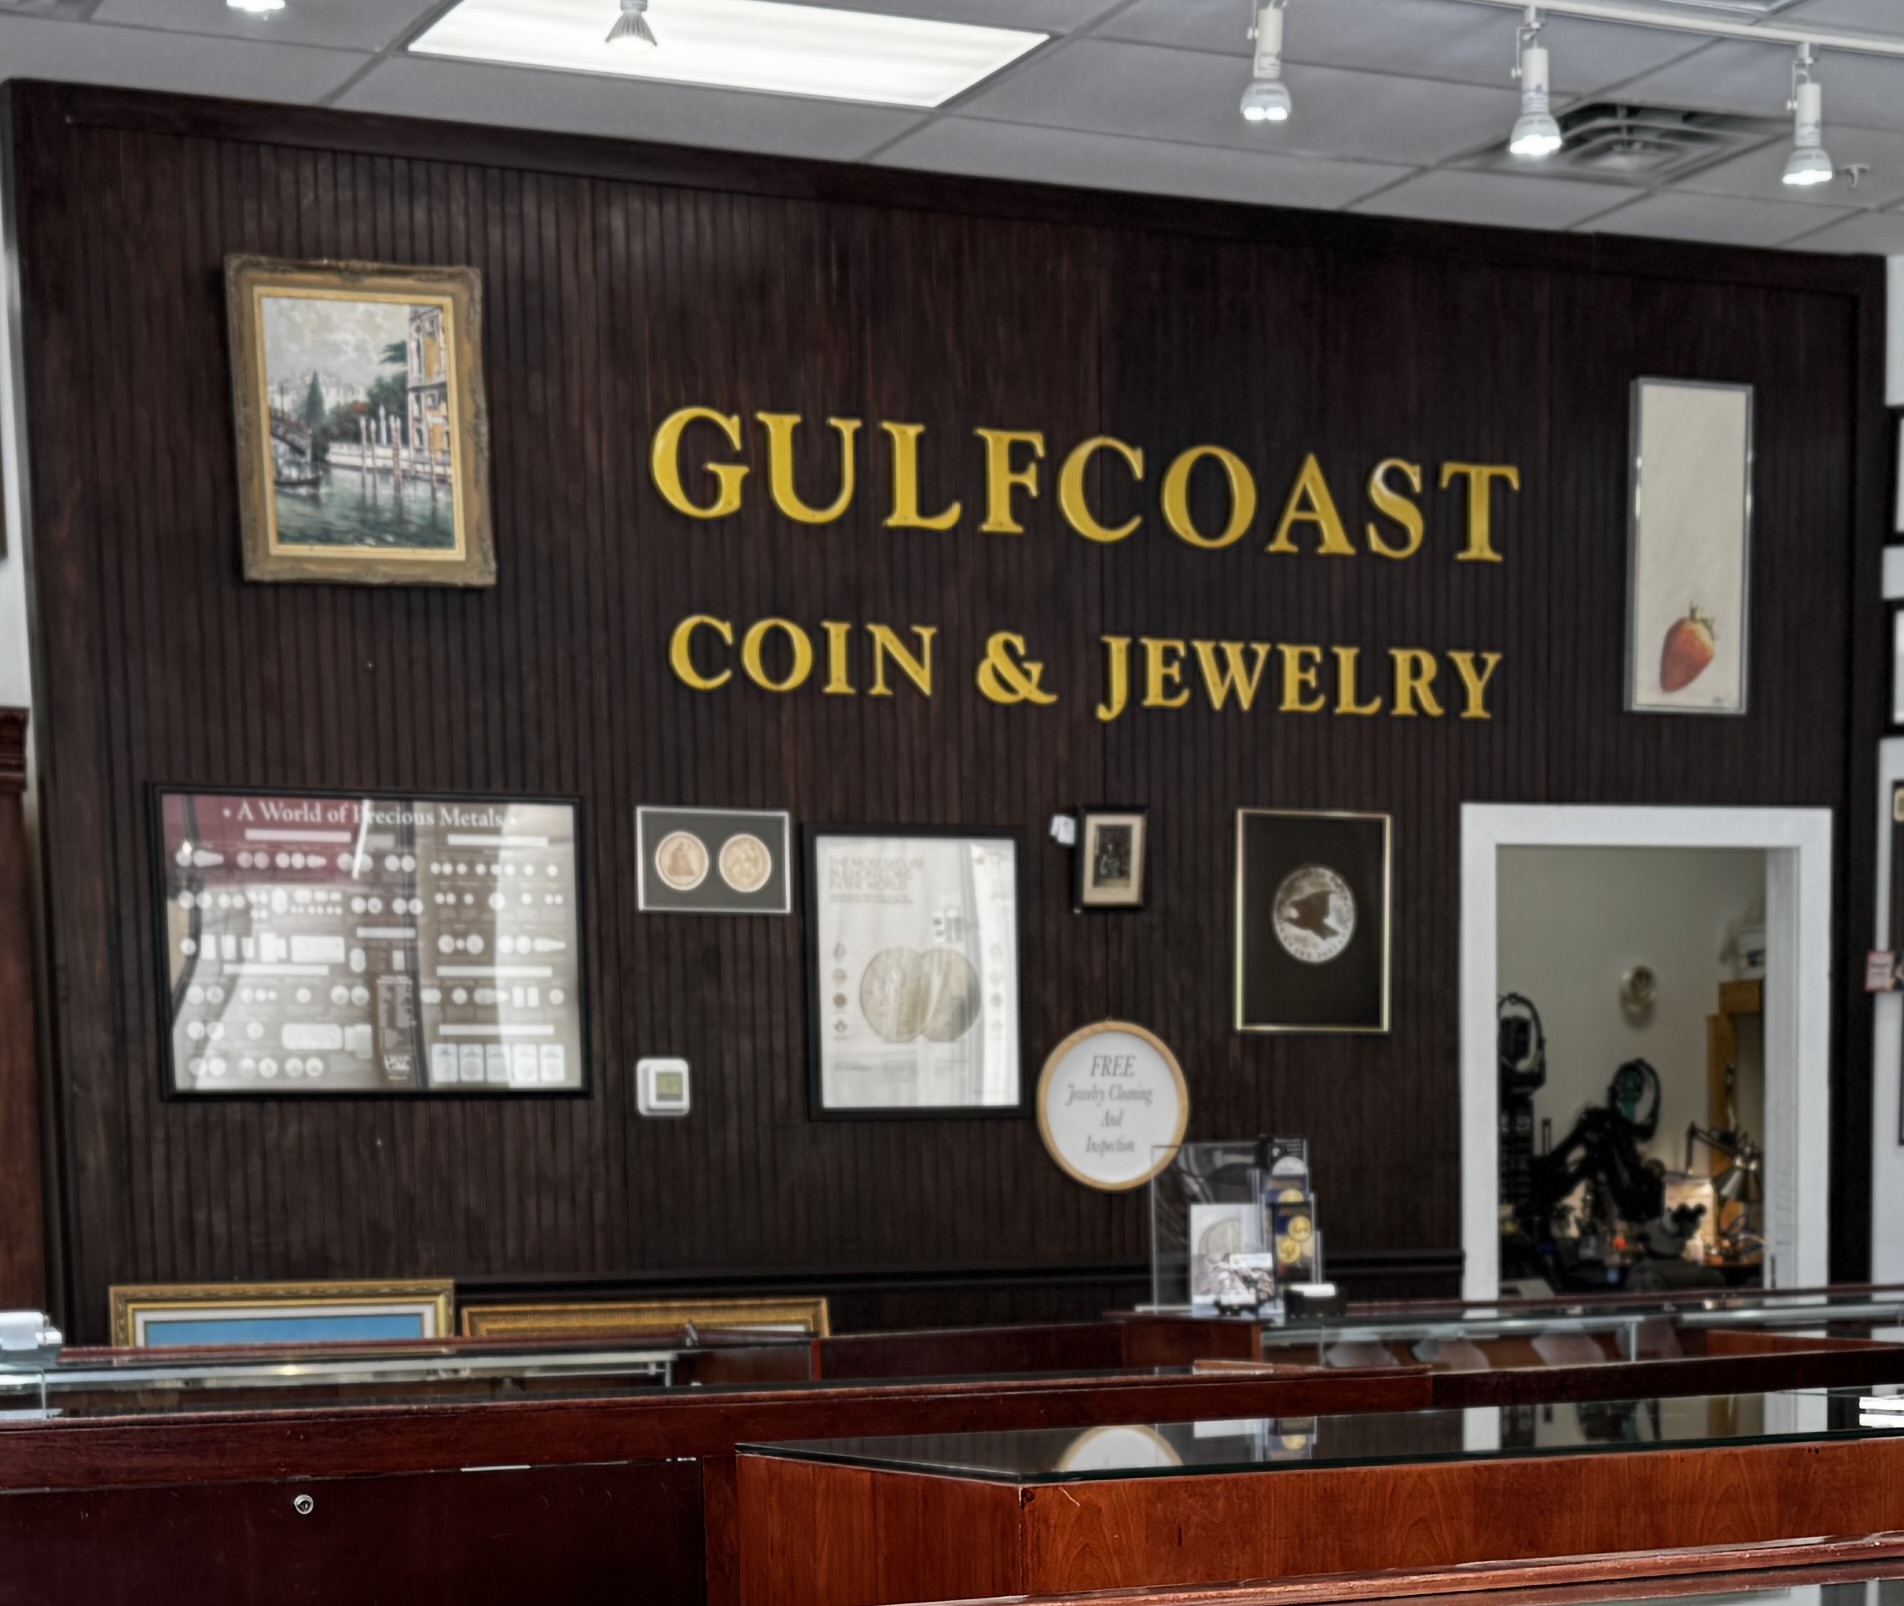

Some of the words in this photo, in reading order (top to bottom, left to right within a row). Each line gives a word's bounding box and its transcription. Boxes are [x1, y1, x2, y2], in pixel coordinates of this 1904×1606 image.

[651, 406, 1521, 562] GULFCOAST
[668, 614, 937, 697] COIN
[977, 632, 1058, 705] &
[1096, 635, 1502, 721] JEWELRY
[237, 801, 254, 820] A
[260, 802, 323, 822] World
[327, 803, 349, 823] of
[440, 808, 503, 827] Metals
[1090, 1055, 1136, 1078] FREE
[1065, 1083, 1105, 1106] Jewelry
[1108, 1083, 1153, 1106] Cleaning
[1100, 1109, 1124, 1128] And
[1086, 1134, 1135, 1158] Inspection
